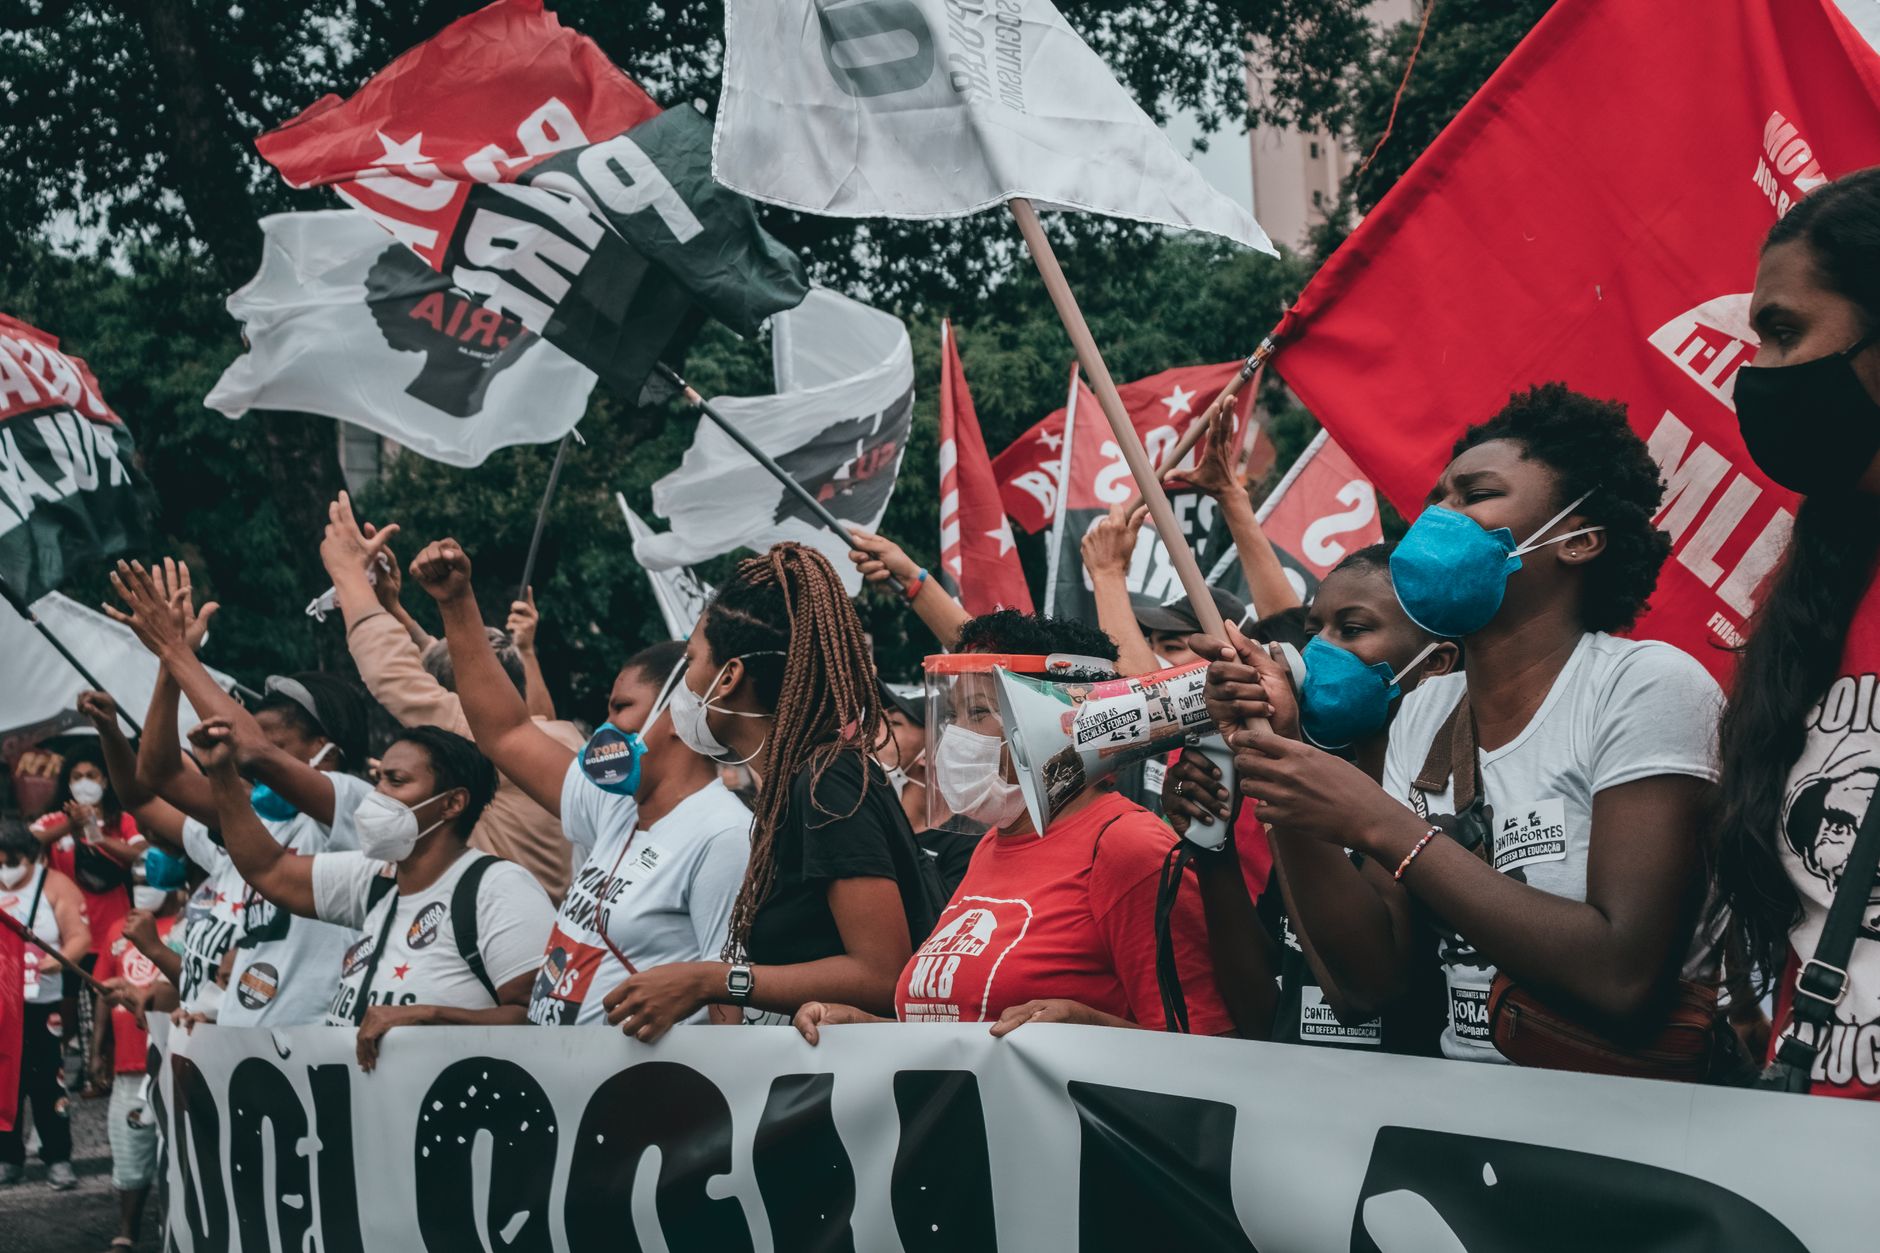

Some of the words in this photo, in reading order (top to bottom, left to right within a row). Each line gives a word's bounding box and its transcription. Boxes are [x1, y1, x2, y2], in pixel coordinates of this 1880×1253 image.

[1179, 692, 1207, 711] CONTR
[1077, 711, 1108, 730] DEFENDO
[1108, 707, 1118, 717] AS
[1106, 710, 1138, 731] FEDERAIS
[585, 750, 630, 765] BOLSONARO
[593, 741, 628, 757] FORA
[1520, 824, 1564, 843] CORTES
[908, 955, 961, 999] MLB
[1304, 1006, 1335, 1020] CONTR
[1454, 1000, 1489, 1023] FORA
[1306, 1025, 1315, 1033] EM
[1316, 1025, 1337, 1035] DEFESA
[1337, 1027, 1346, 1035] DA
